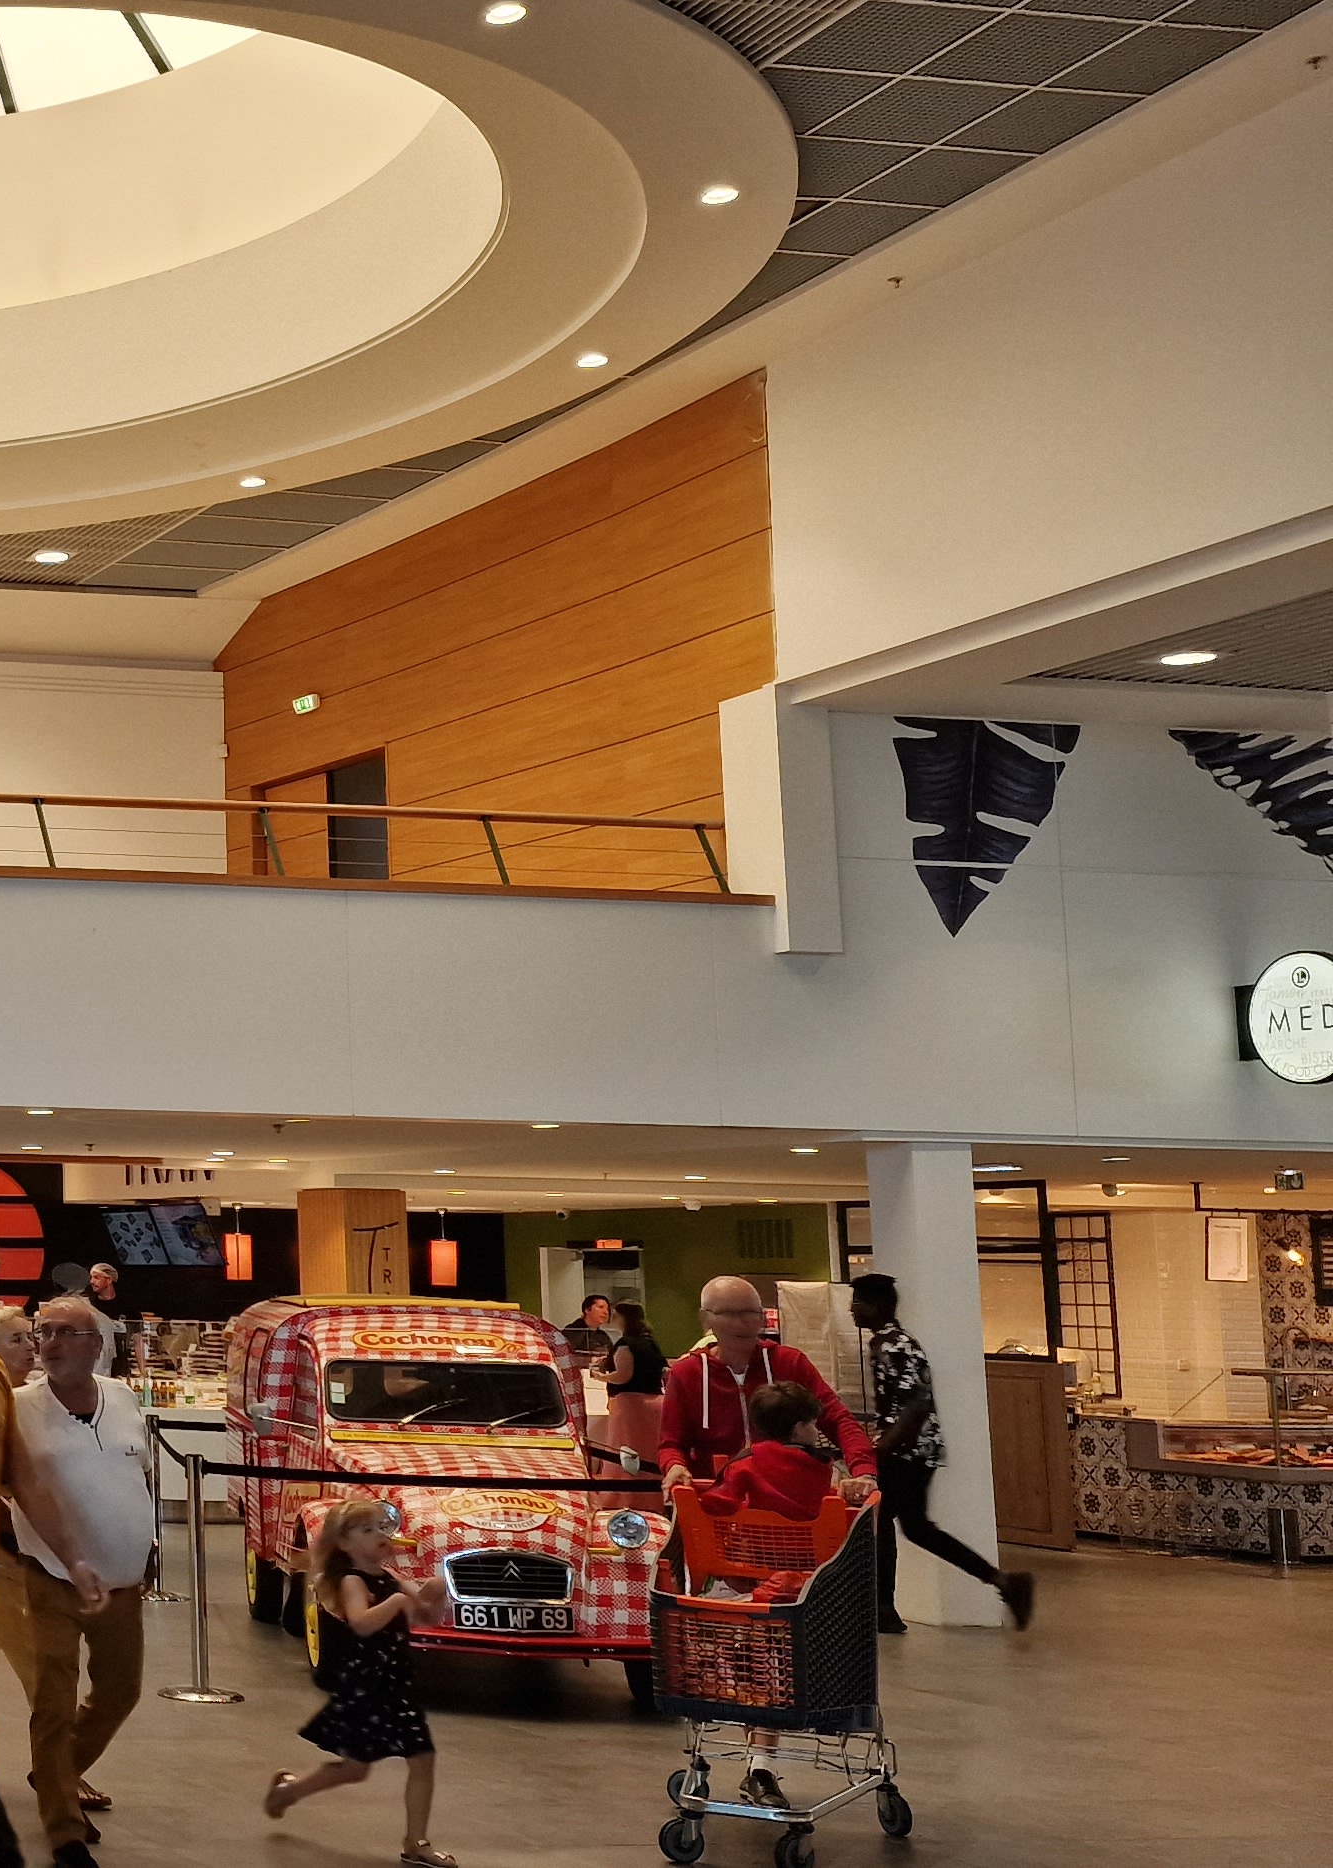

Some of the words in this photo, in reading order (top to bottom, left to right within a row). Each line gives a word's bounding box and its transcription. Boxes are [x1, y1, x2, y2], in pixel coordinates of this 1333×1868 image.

[361, 1333, 498, 1348] Cochonou
[446, 1494, 548, 1512] Cochonou
[460, 1604, 499, 1628] 661
[507, 1607, 535, 1629] WP
[541, 1608, 568, 1630] 69
